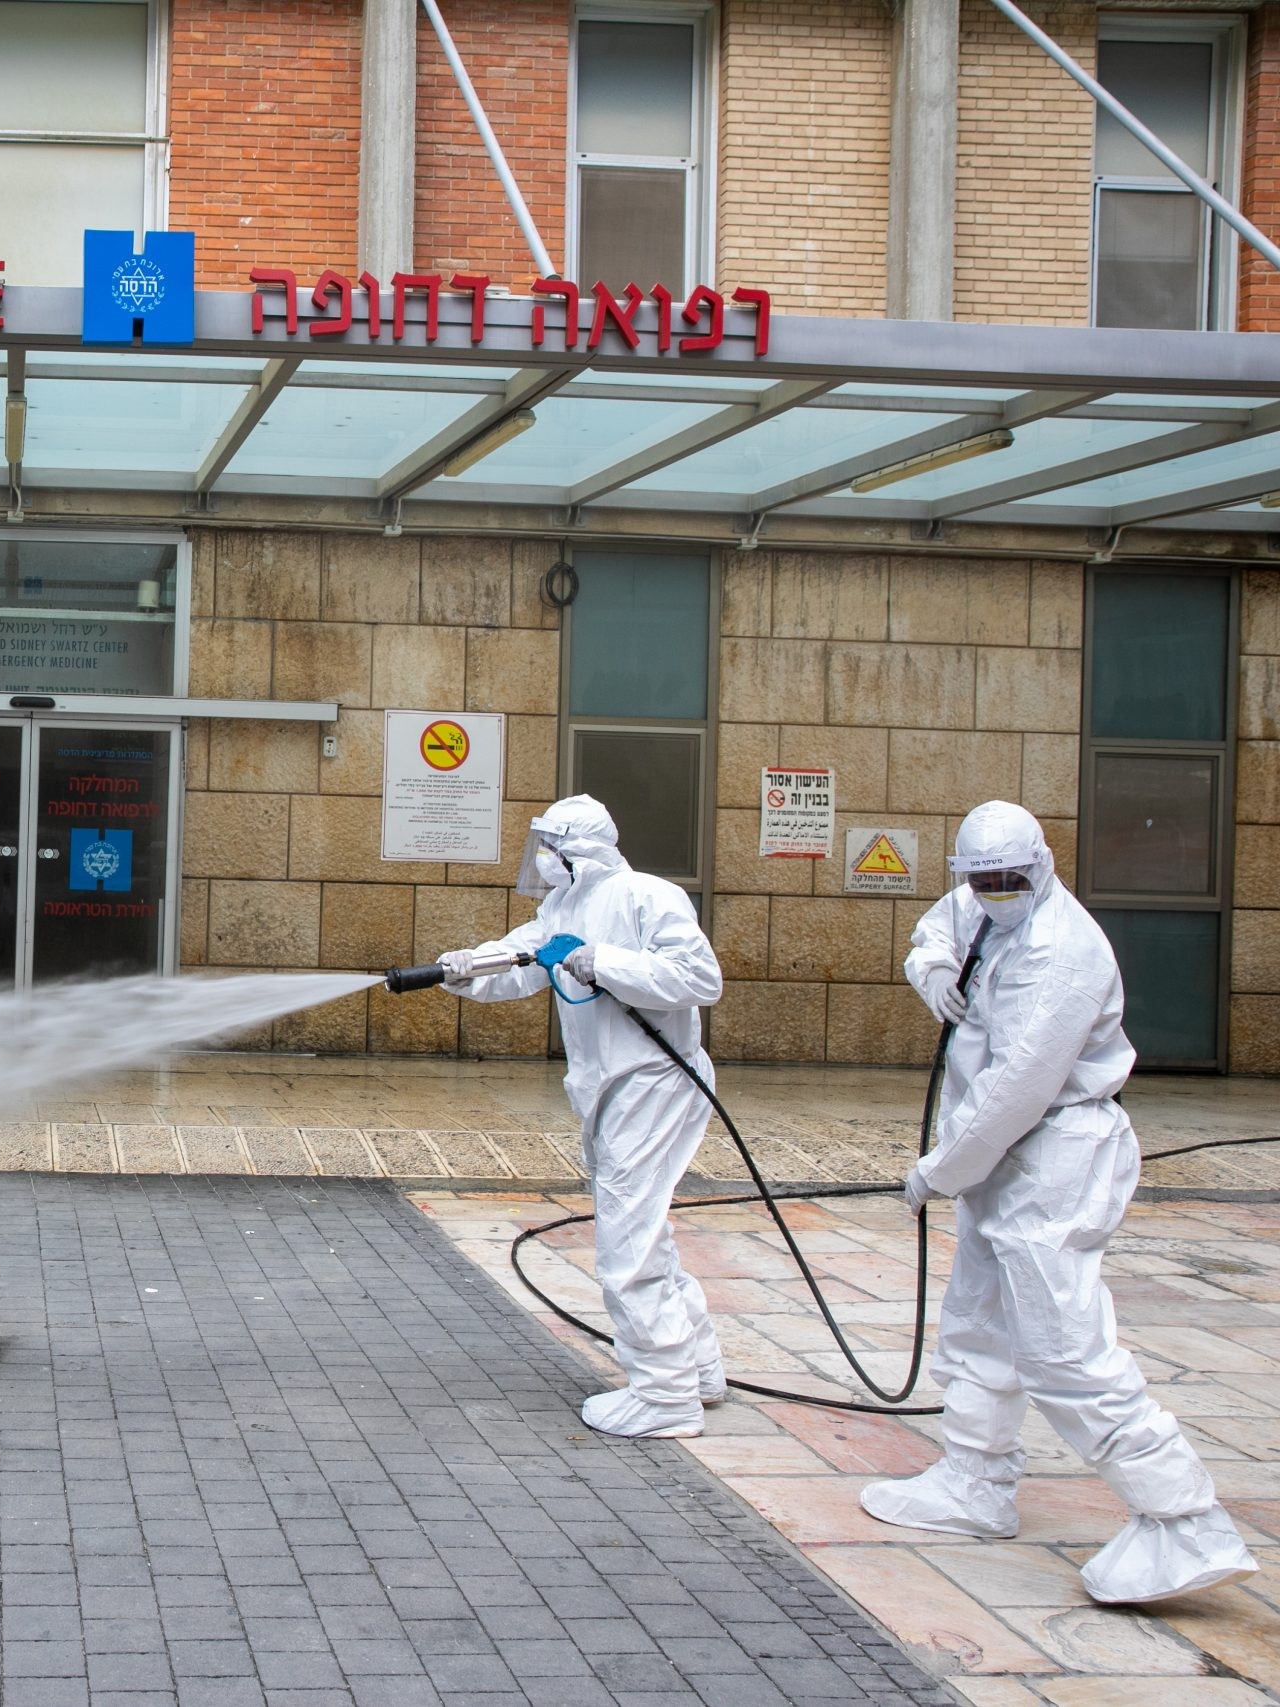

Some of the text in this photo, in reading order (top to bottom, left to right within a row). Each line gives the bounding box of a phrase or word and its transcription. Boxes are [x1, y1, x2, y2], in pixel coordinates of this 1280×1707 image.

[119, 280, 158, 293] הדסה
[249, 266, 770, 356] רפואה דחופה
[0, 619, 46, 634] ושמואל
[52, 619, 76, 635] רחל
[10, 639, 47, 652] SIDNEY
[50, 640, 89, 652] SWARTZ
[93, 641, 128, 654] CENTER
[50, 656, 98, 669] MEDICINE
[67, 773, 139, 796] המחלקה
[768, 774, 829, 790] העישון אסור
[791, 793, 829, 808] בבנין זה
[48, 801, 160, 818] לרפואה דחופה
[851, 874, 884, 883] מהחלקה
[44, 900, 156, 918] יחידת הטראומה
